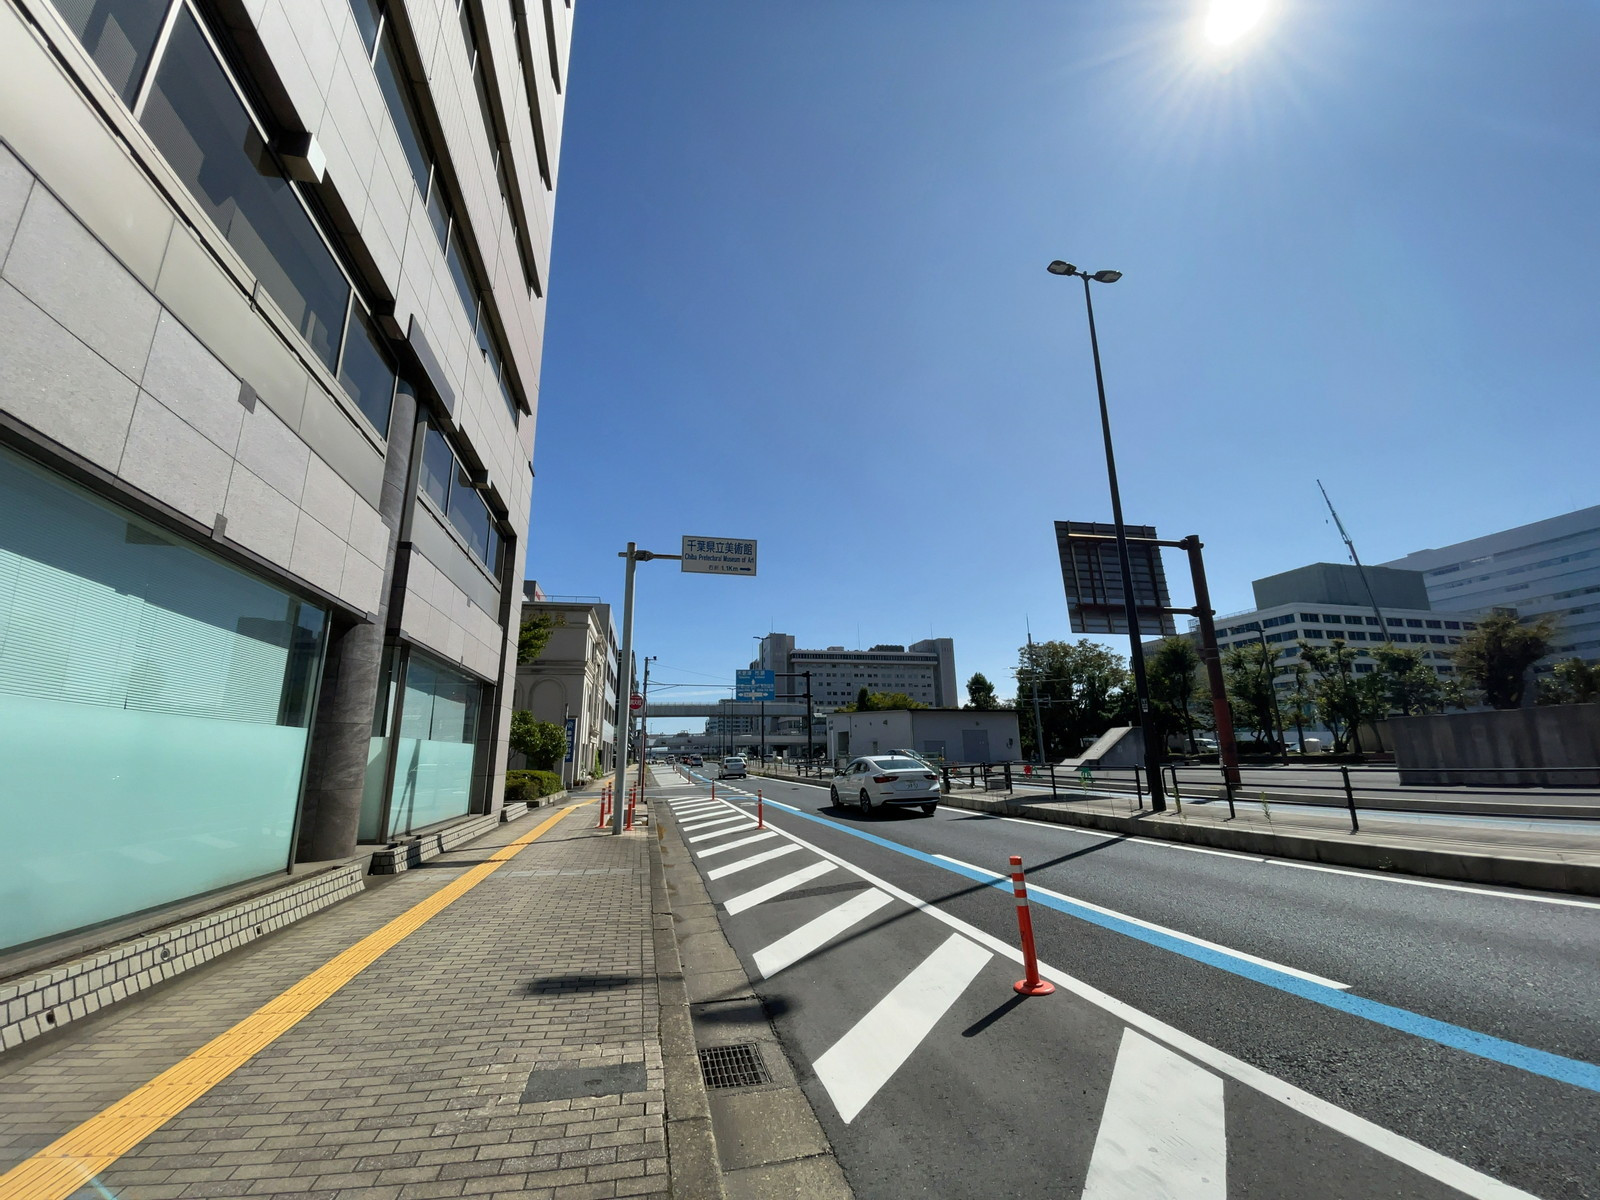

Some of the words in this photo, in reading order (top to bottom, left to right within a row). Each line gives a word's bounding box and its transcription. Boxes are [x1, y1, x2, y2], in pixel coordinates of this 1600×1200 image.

[687, 540, 753, 555] 千葉県立美術館
